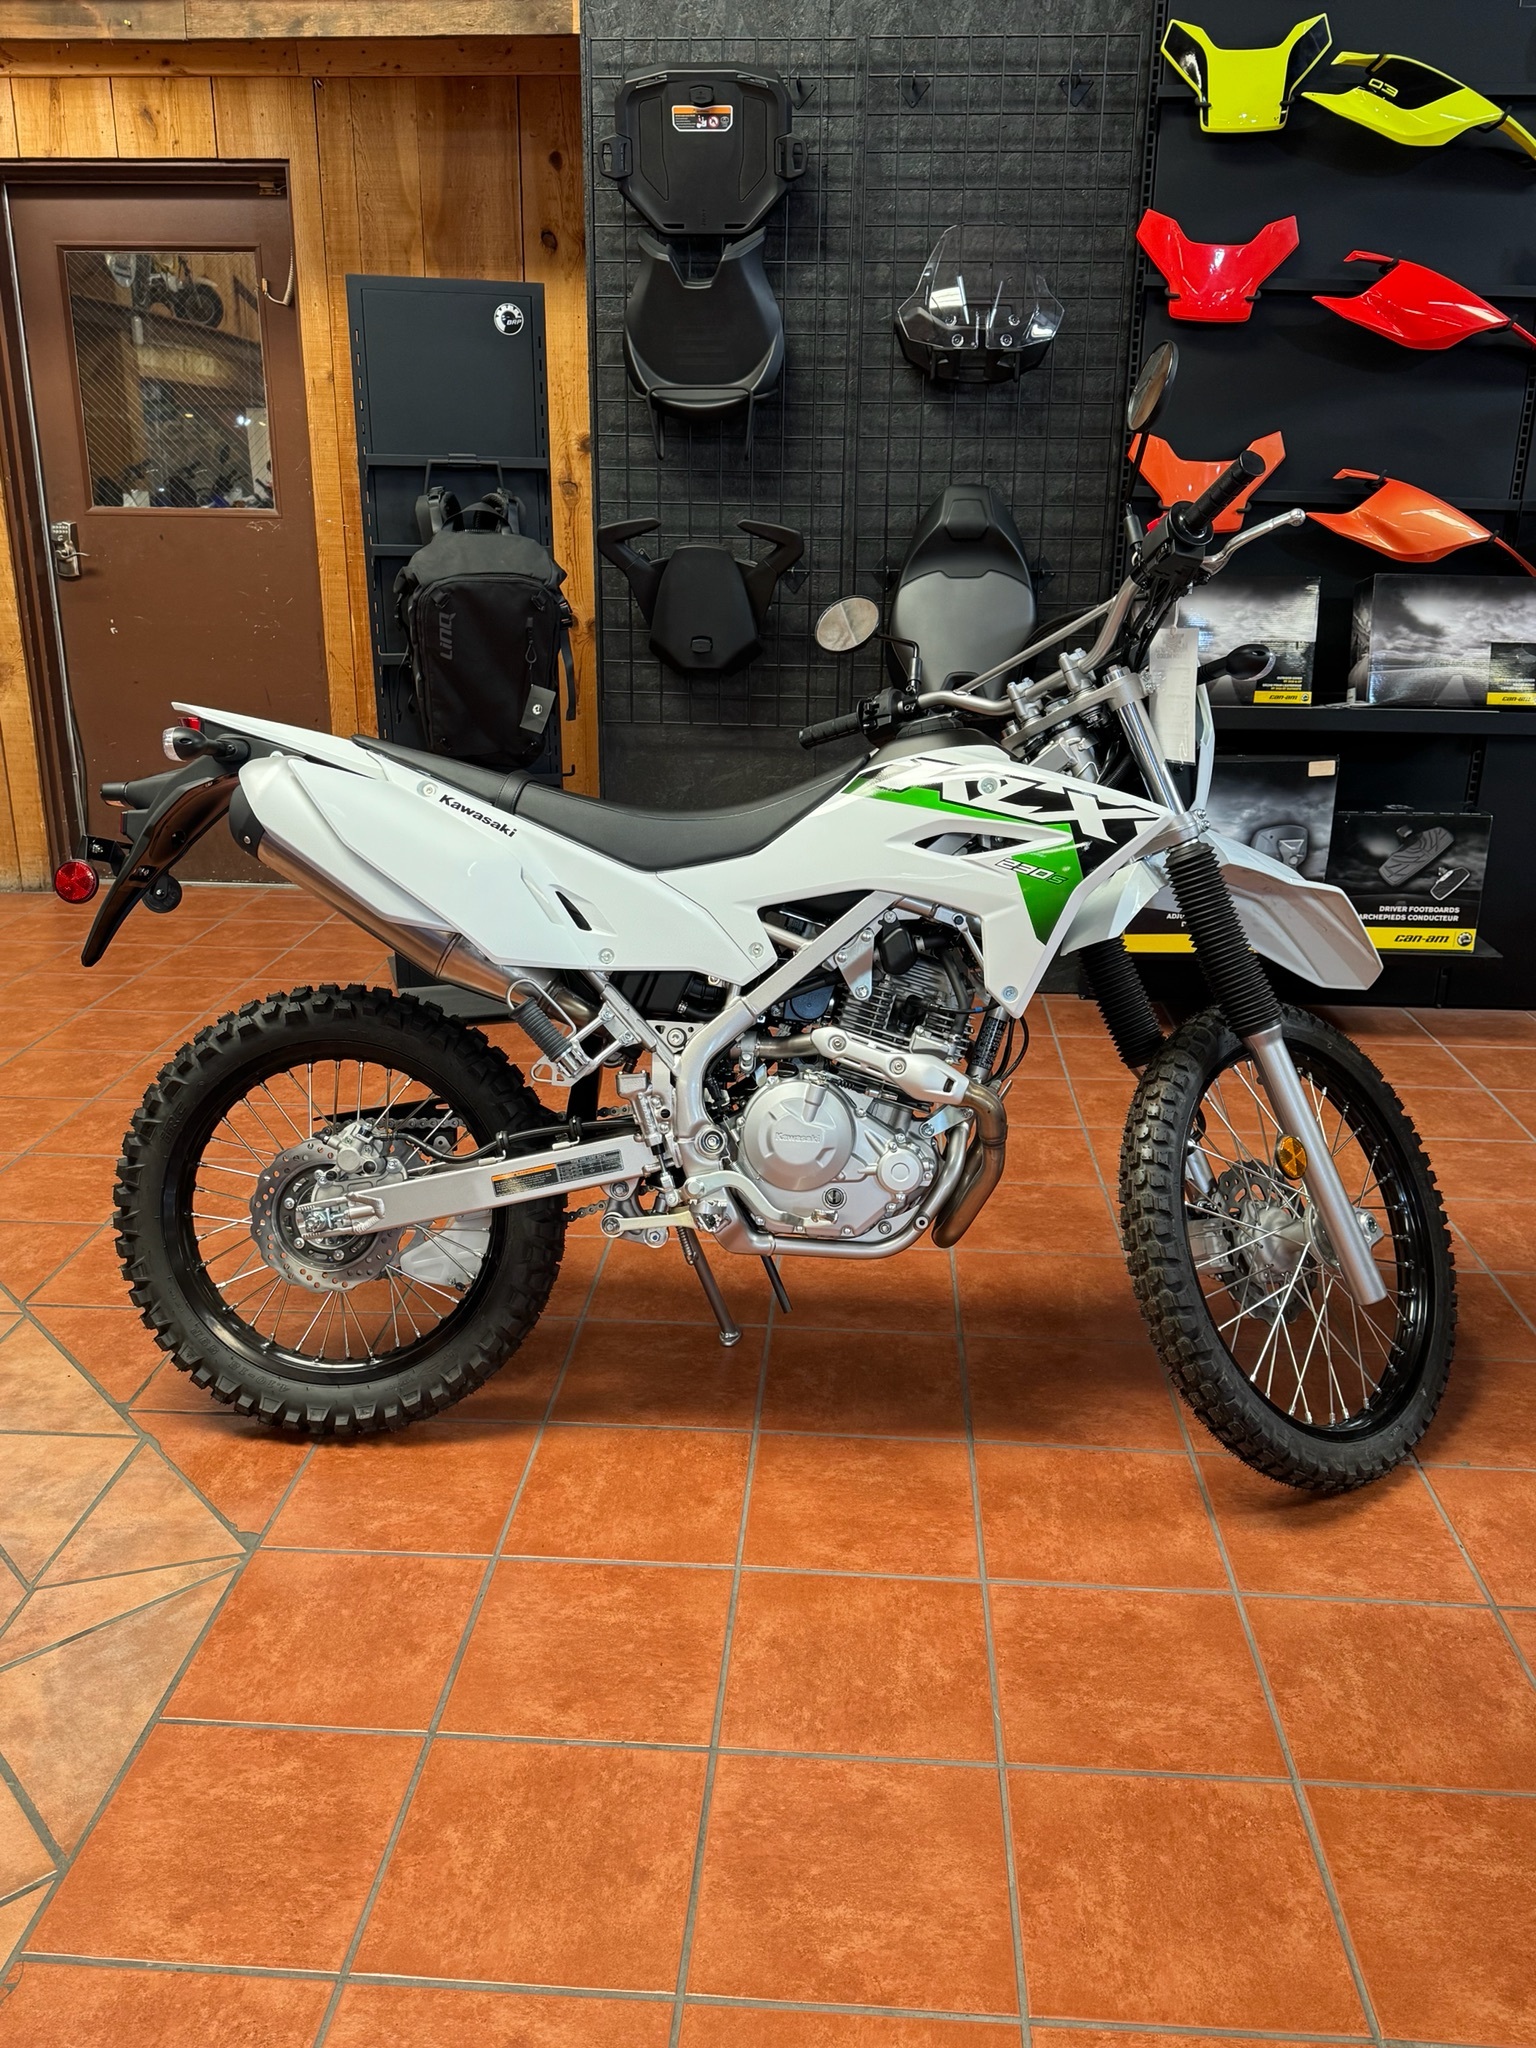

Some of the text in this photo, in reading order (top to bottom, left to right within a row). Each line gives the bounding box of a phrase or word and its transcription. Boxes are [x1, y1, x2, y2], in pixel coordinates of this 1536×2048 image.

[439, 794, 518, 838] Kawasaki
[1408, 906, 1460, 914] FOOTBOARDS
[1359, 913, 1459, 922] ARCHEPIEDS CONDUCTEUR
[1394, 935, 1450, 943] can-am
[775, 1131, 821, 1143] Kawasaki
